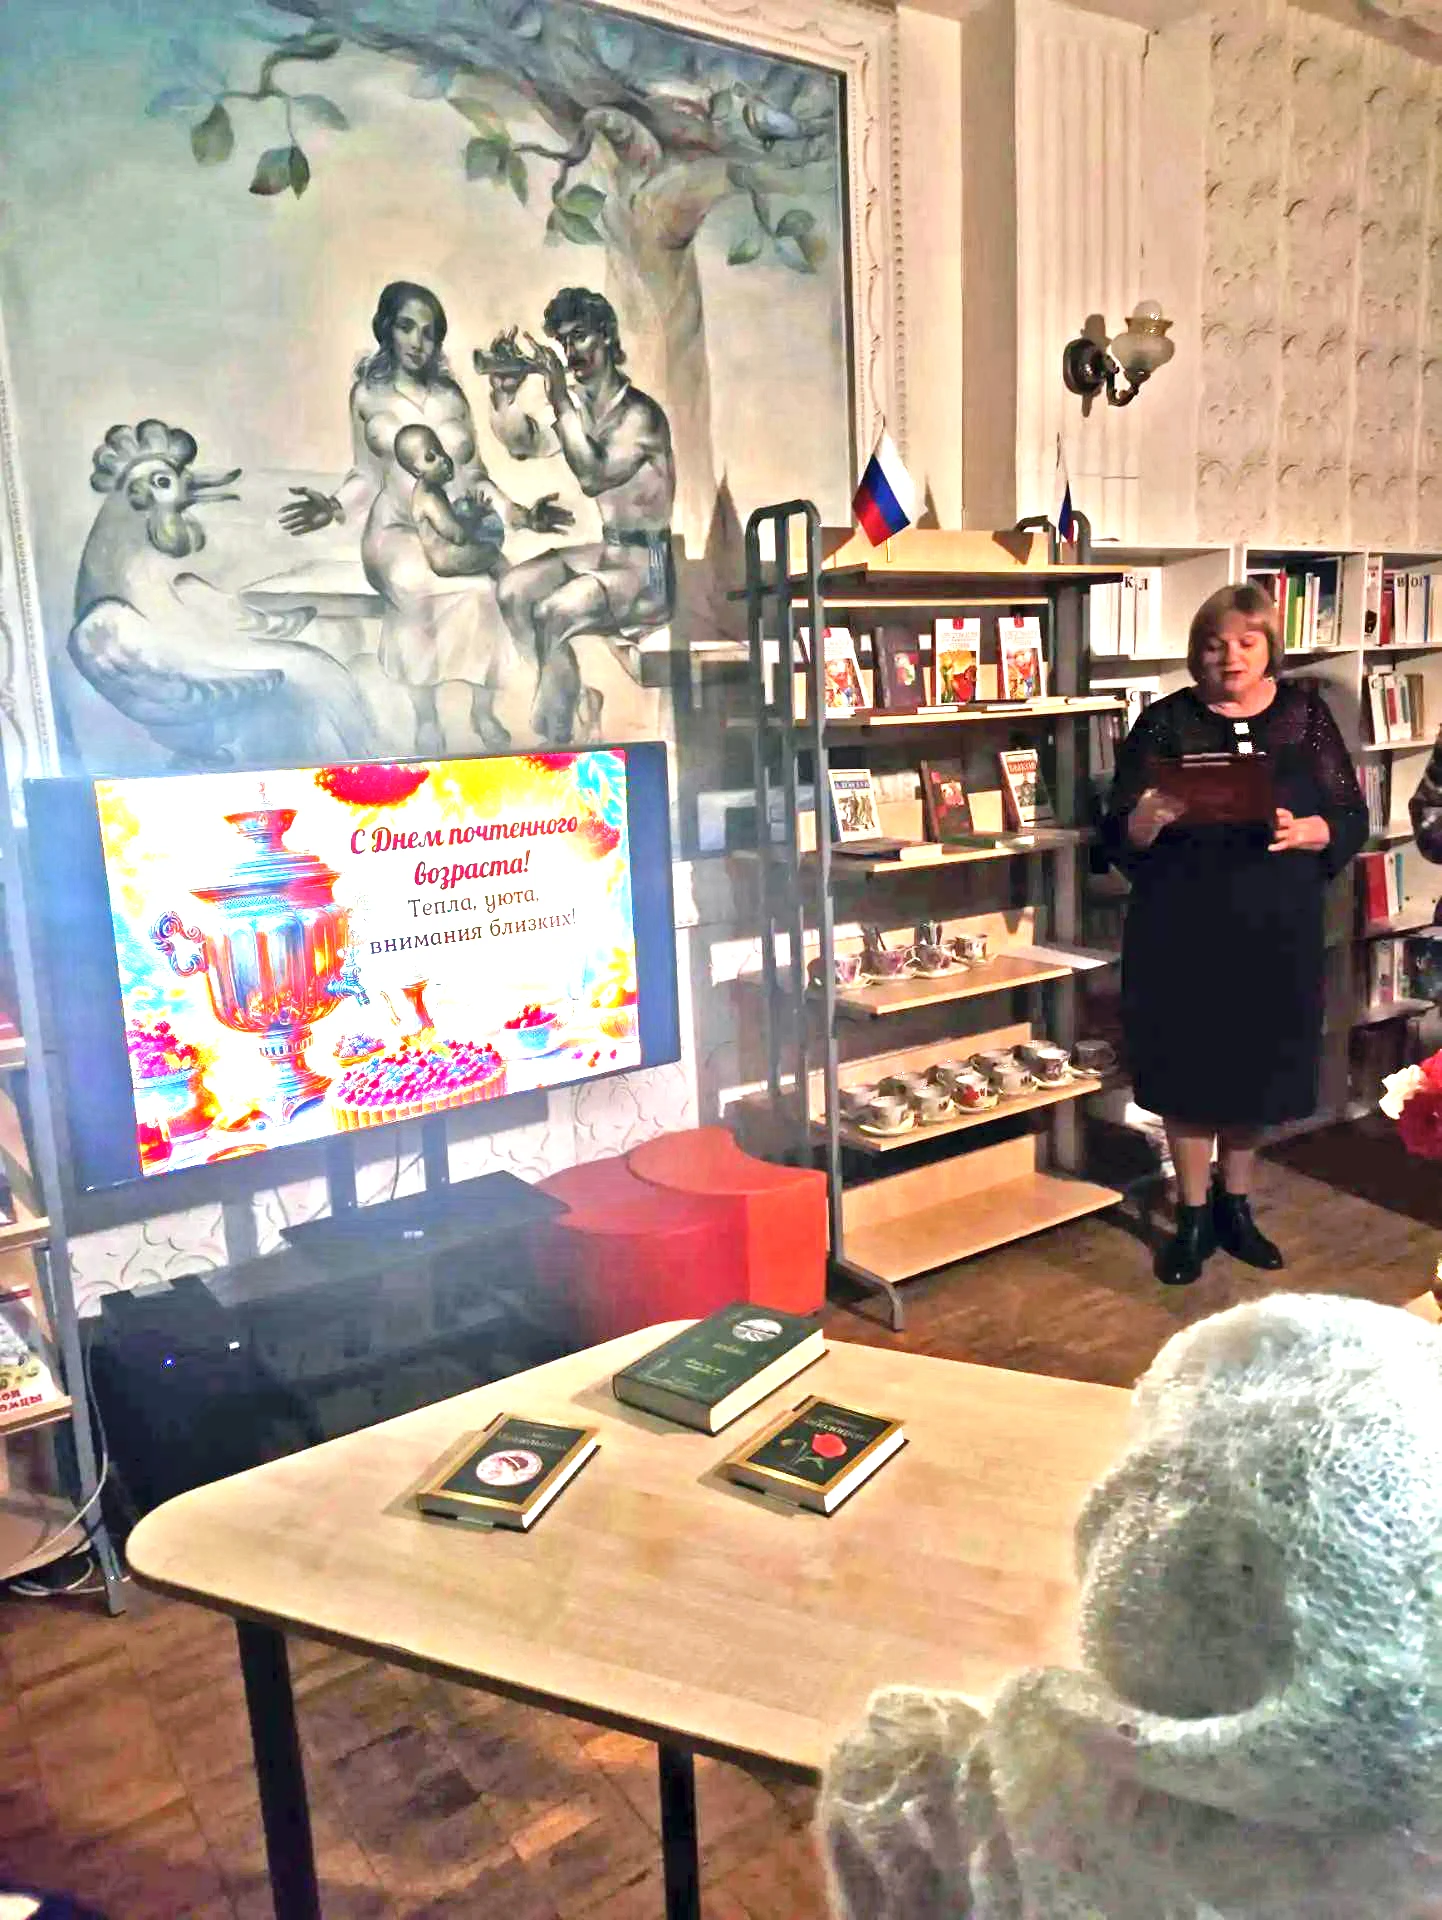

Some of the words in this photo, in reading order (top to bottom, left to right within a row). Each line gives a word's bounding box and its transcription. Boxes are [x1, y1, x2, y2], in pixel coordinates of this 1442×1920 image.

[351, 829, 366, 854] С
[372, 826, 445, 853] Днем
[448, 816, 578, 845] почтенного
[414, 850, 531, 889] возраста!
[408, 898, 477, 918] Тепла,
[485, 889, 540, 914] уюта,
[369, 926, 483, 954] внимания
[489, 908, 576, 937] близких!
